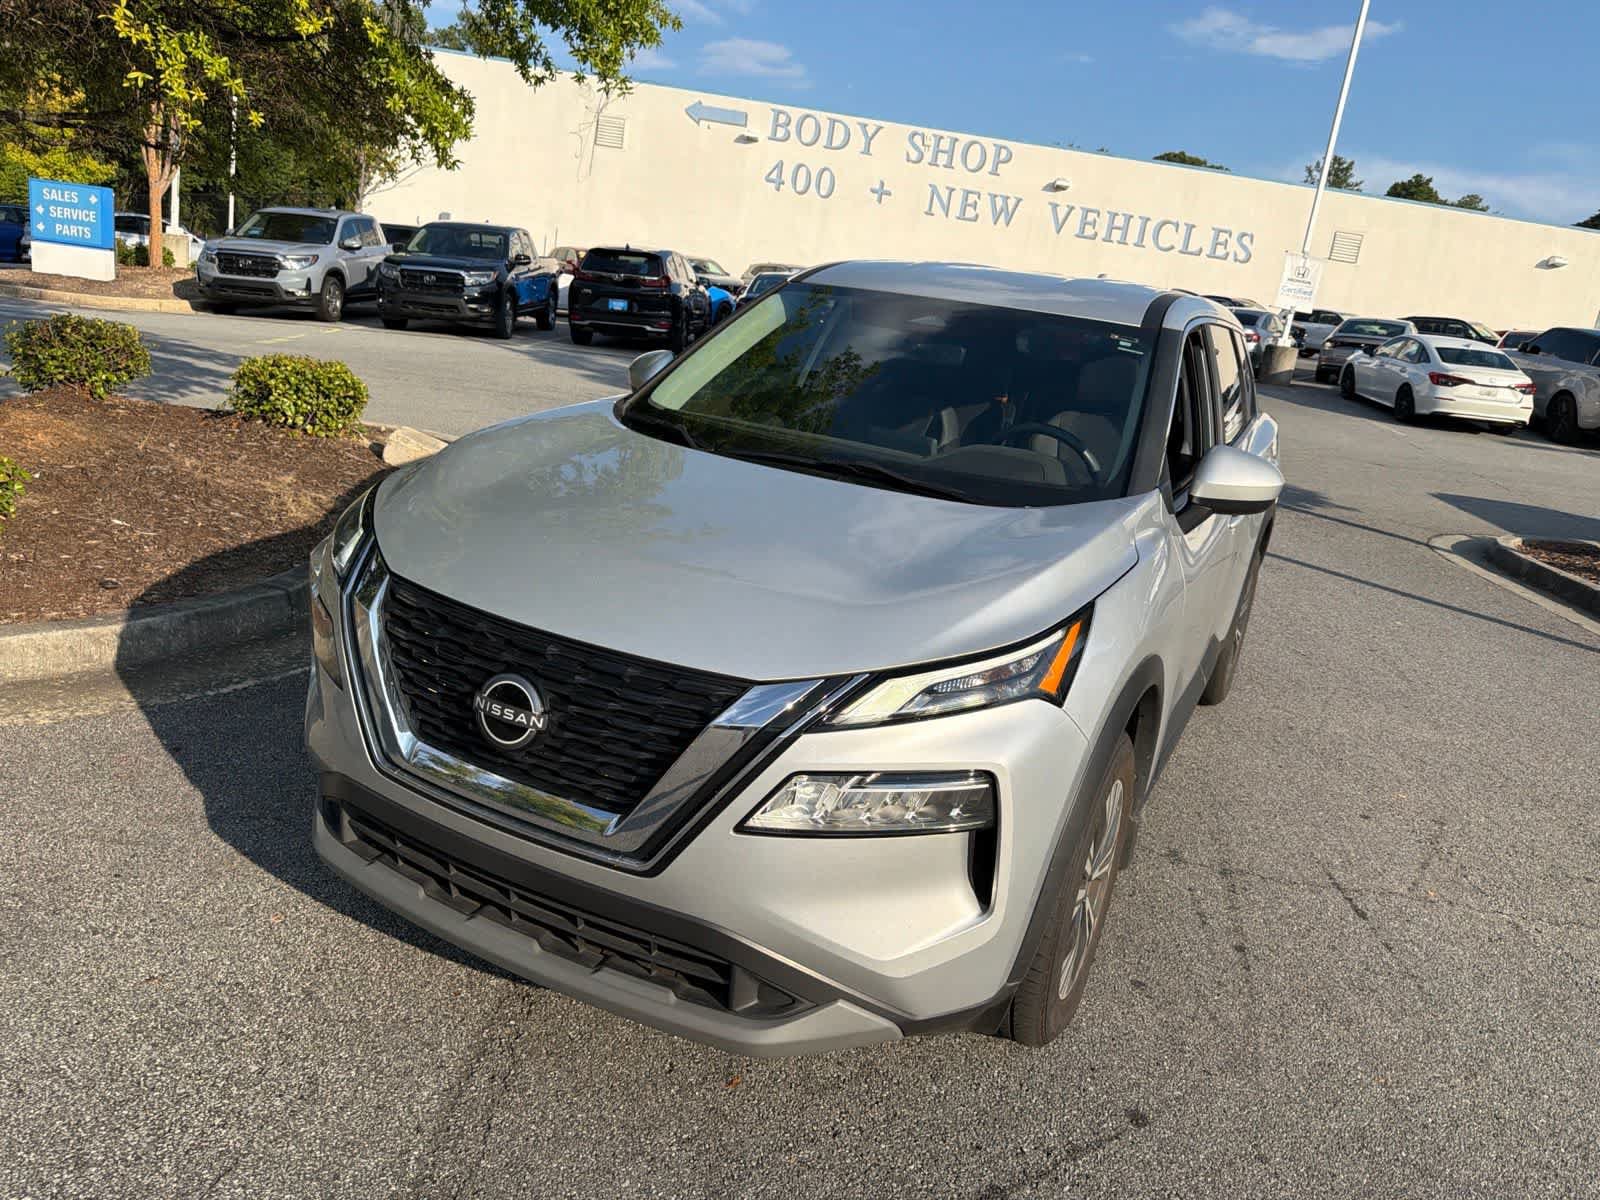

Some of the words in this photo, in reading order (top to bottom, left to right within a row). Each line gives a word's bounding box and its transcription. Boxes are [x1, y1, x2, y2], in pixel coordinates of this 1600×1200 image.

[767, 108, 883, 155] BODY
[905, 131, 1013, 176] SHOP
[42, 187, 79, 203] SALES
[49, 206, 97, 222] SERVICE
[765, 160, 836, 199] 400
[870, 181, 892, 204] +
[925, 183, 1022, 227] NEW
[1048, 201, 1254, 264] VEHICLES
[55, 223, 92, 239] PARTS
[475, 695, 544, 729] NISSAN
